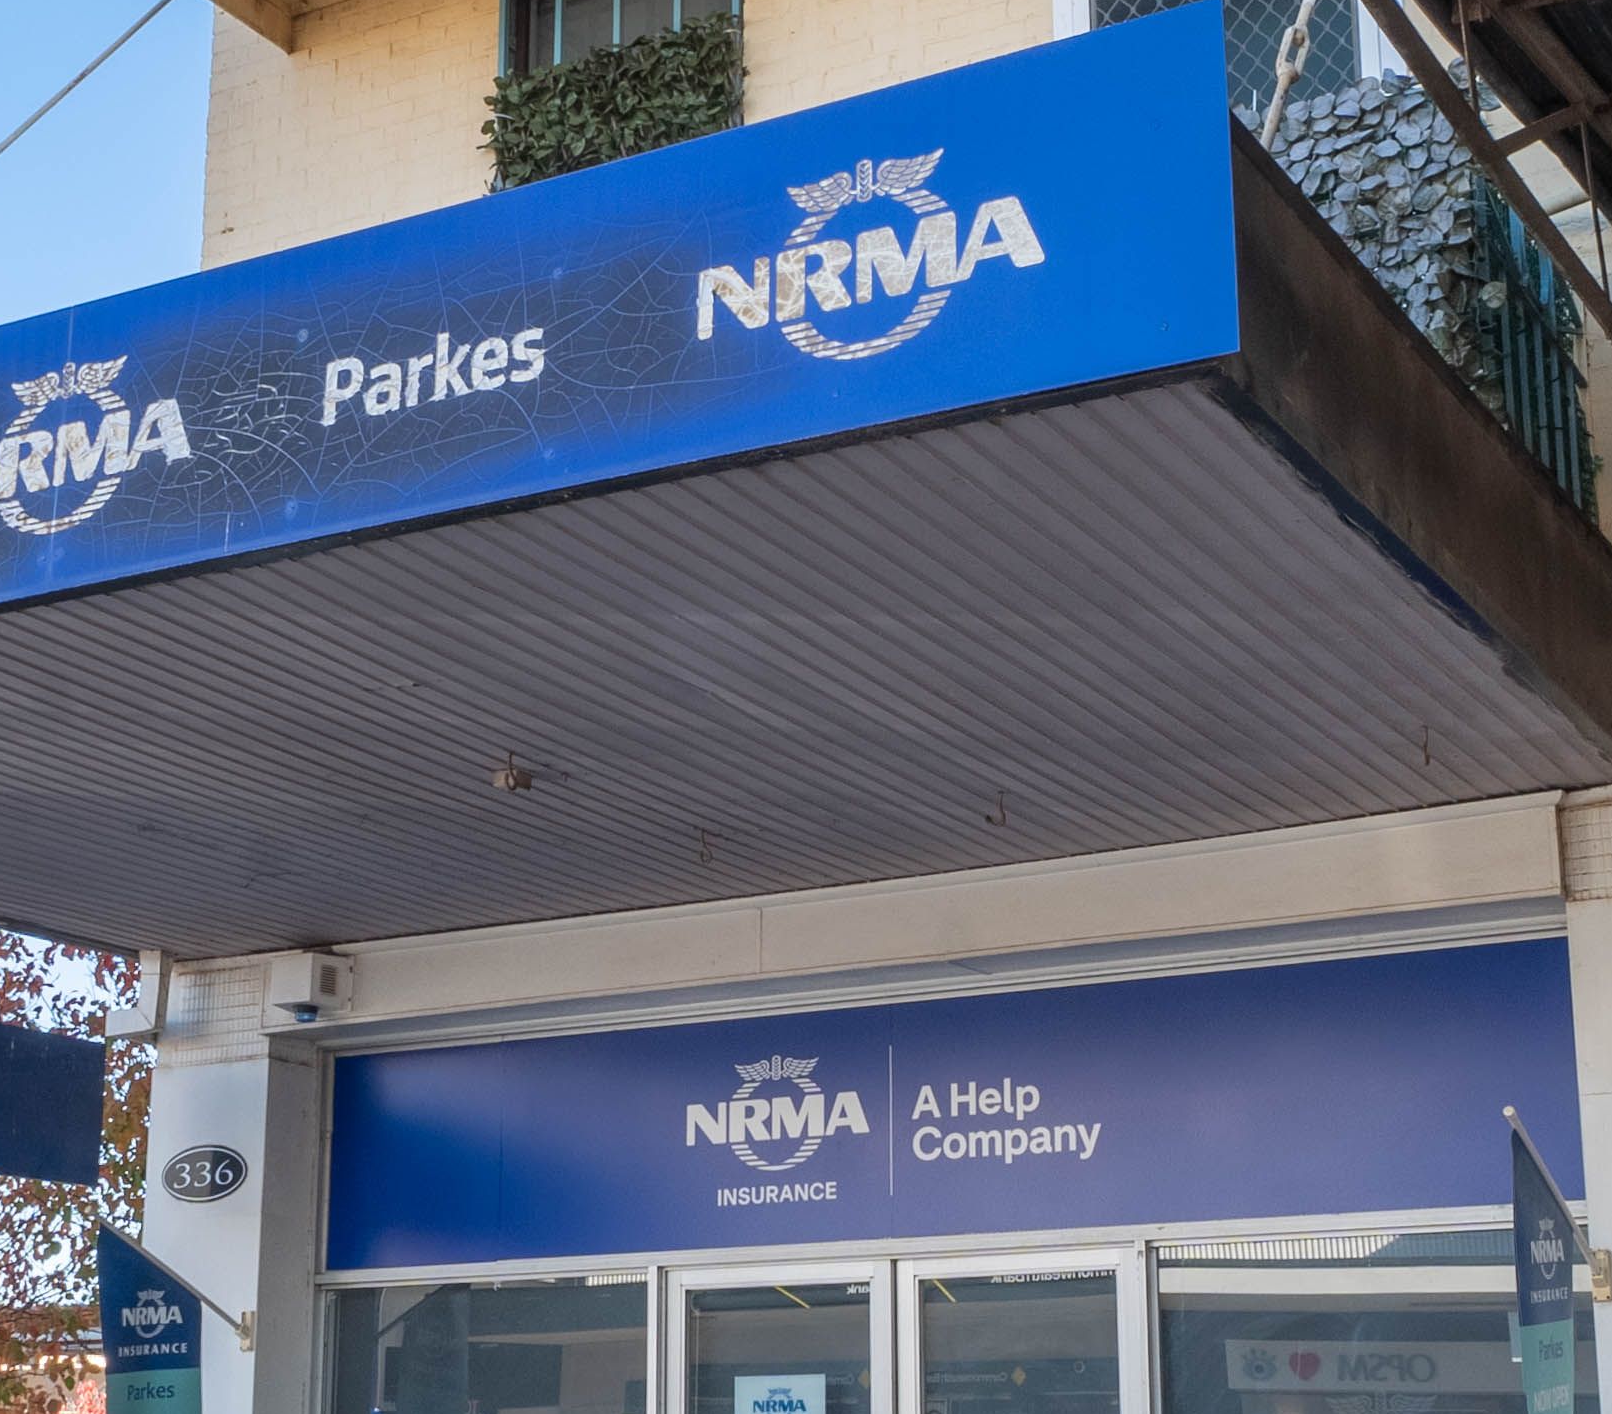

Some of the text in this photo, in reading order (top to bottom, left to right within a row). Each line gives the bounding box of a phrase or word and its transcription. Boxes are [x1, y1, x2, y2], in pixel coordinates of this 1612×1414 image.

[322, 326, 545, 427] Parkes
[696, 195, 1045, 340] NRMA
[912, 1077, 1040, 1121] A Help
[686, 1090, 870, 1147] NRMA
[911, 1121, 1101, 1165] Company
[173, 1159, 234, 1189] 336
[717, 1181, 837, 1208] INSURANCE
[1531, 1239, 1565, 1265] NRMA
[1530, 1287, 1569, 1304] INSURANCE
[122, 1304, 183, 1327] NRMA
[118, 1343, 188, 1357] INSURANCE
[126, 1381, 175, 1402] Parkes
[753, 1399, 806, 1413] NRMA
